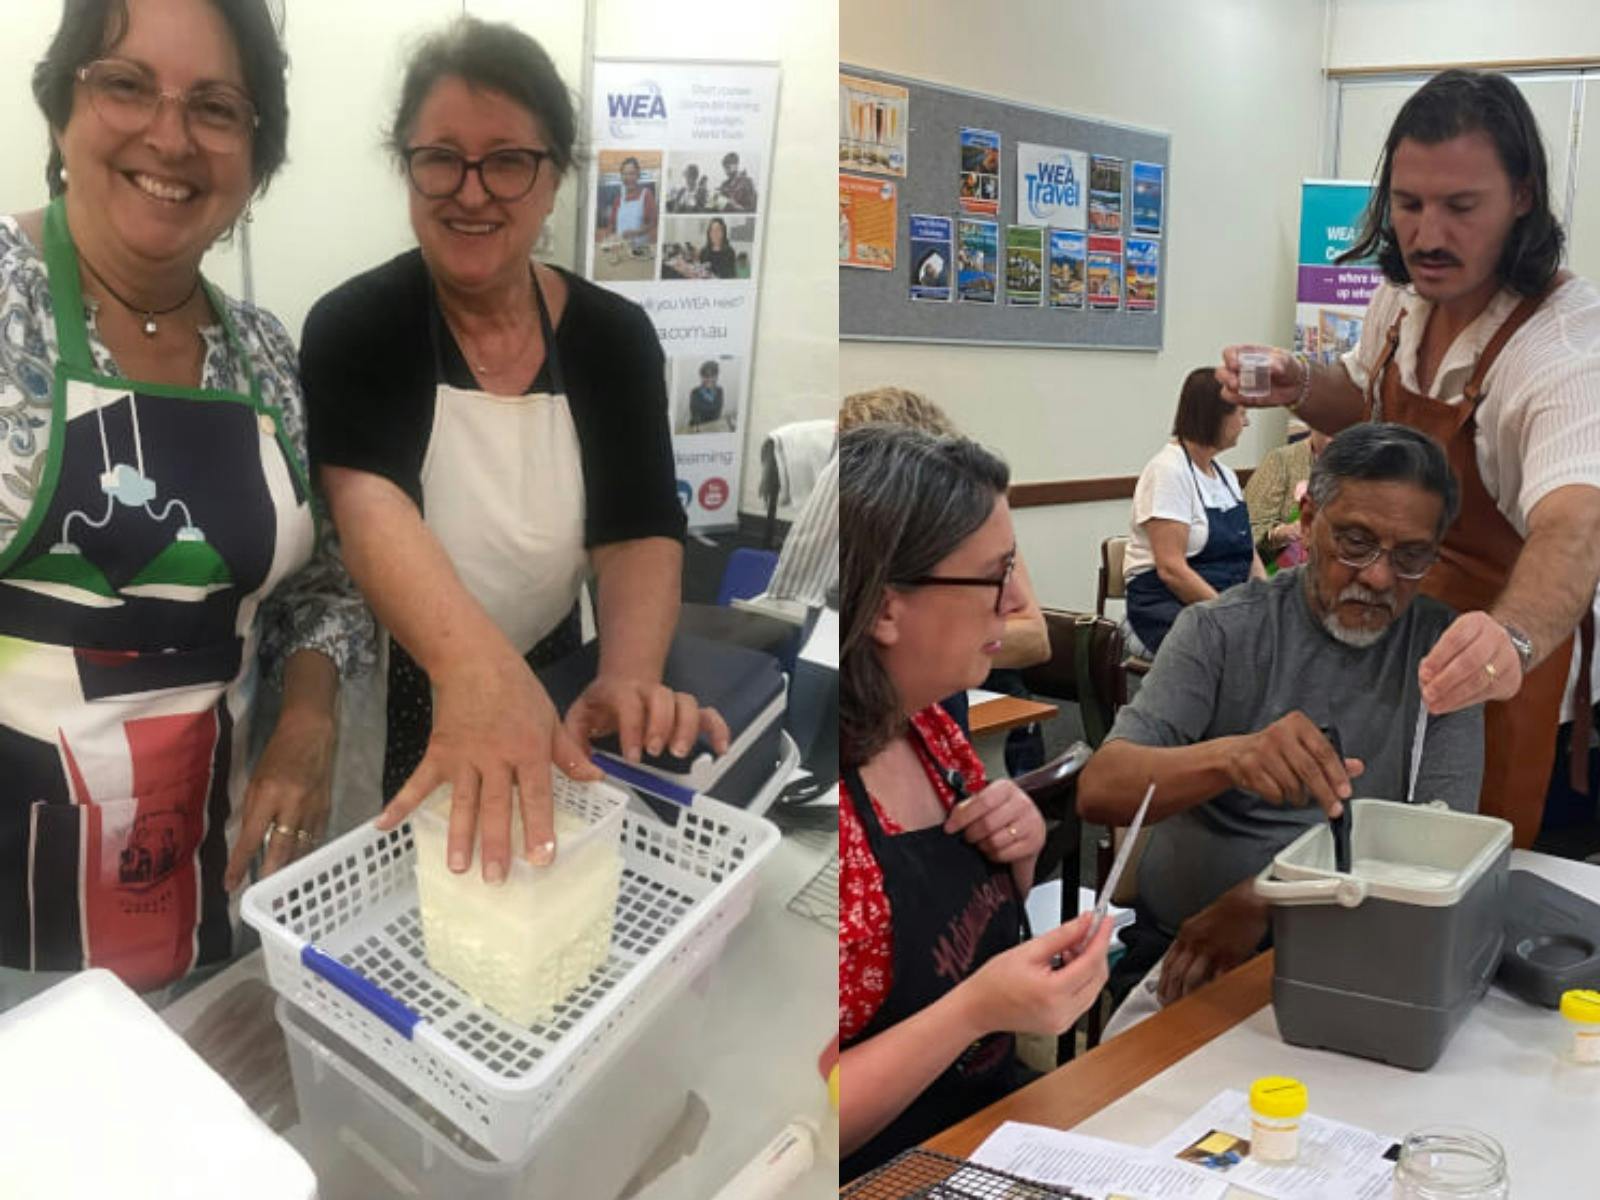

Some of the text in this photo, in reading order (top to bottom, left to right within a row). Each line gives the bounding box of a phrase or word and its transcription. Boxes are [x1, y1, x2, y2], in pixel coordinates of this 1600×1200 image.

[607, 94, 667, 119] WEA
[1038, 162, 1075, 184] WEA
[1024, 173, 1080, 207] Travel
[1327, 226, 1355, 241] WEA
[1338, 271, 1368, 284] where
[678, 296, 710, 310] WEA
[1337, 290, 1350, 302] up
[657, 325, 728, 340] a.com.au
